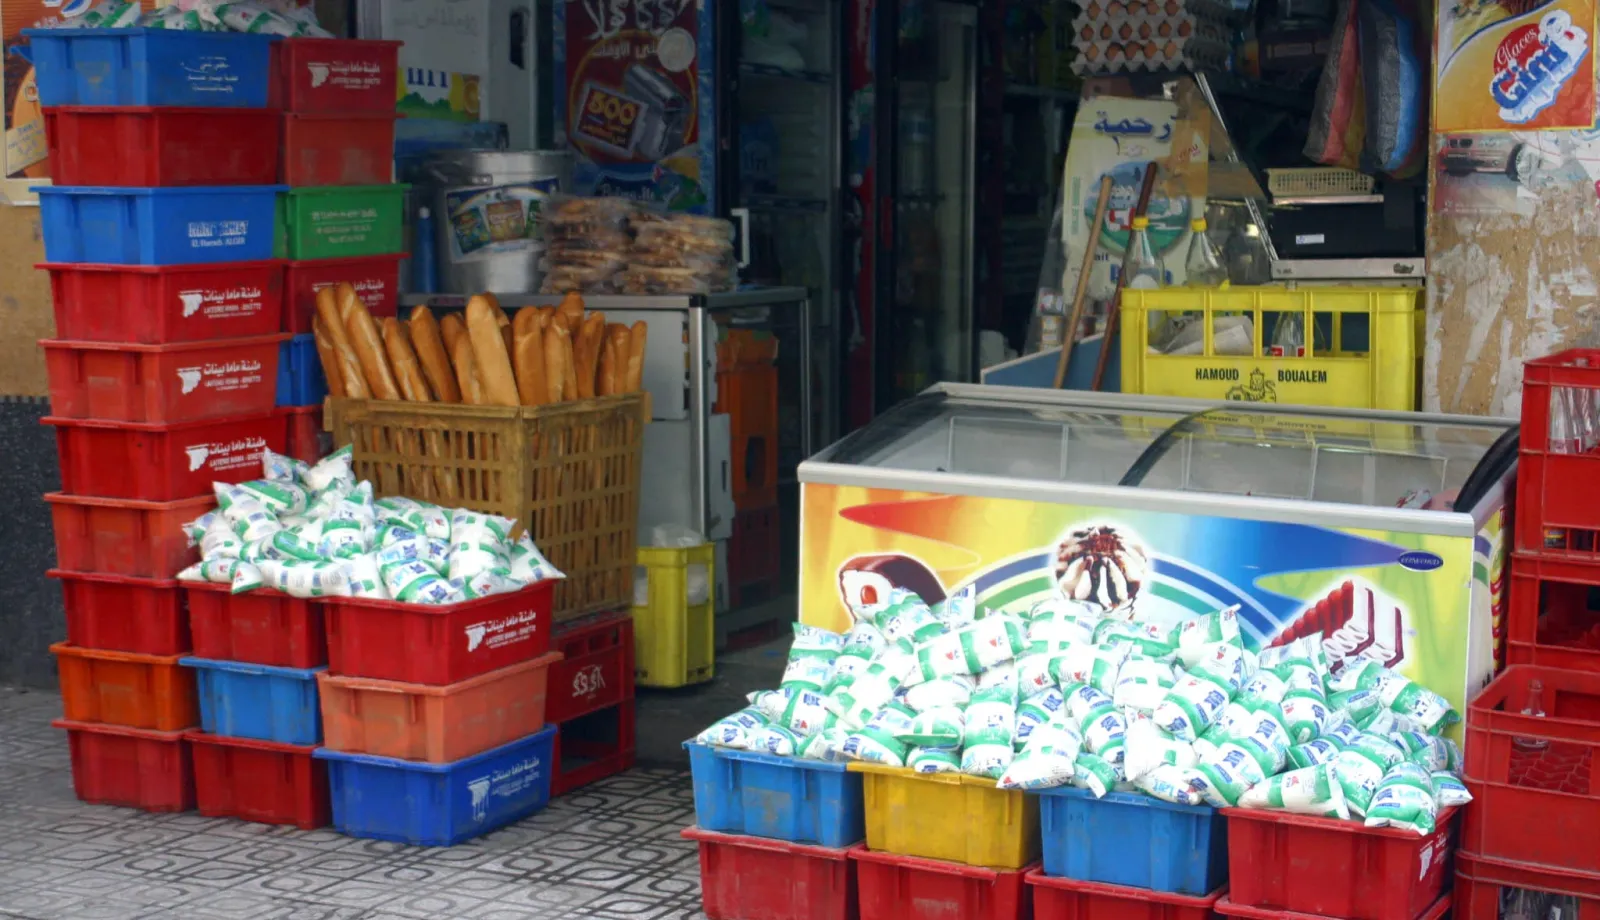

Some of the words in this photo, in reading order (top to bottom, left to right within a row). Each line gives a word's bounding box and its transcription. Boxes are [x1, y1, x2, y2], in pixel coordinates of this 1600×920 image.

[1497, 28, 1537, 65] Glaces
[1195, 368, 1239, 381] HAMOUD
[1277, 369, 1327, 383] BOUALEM
